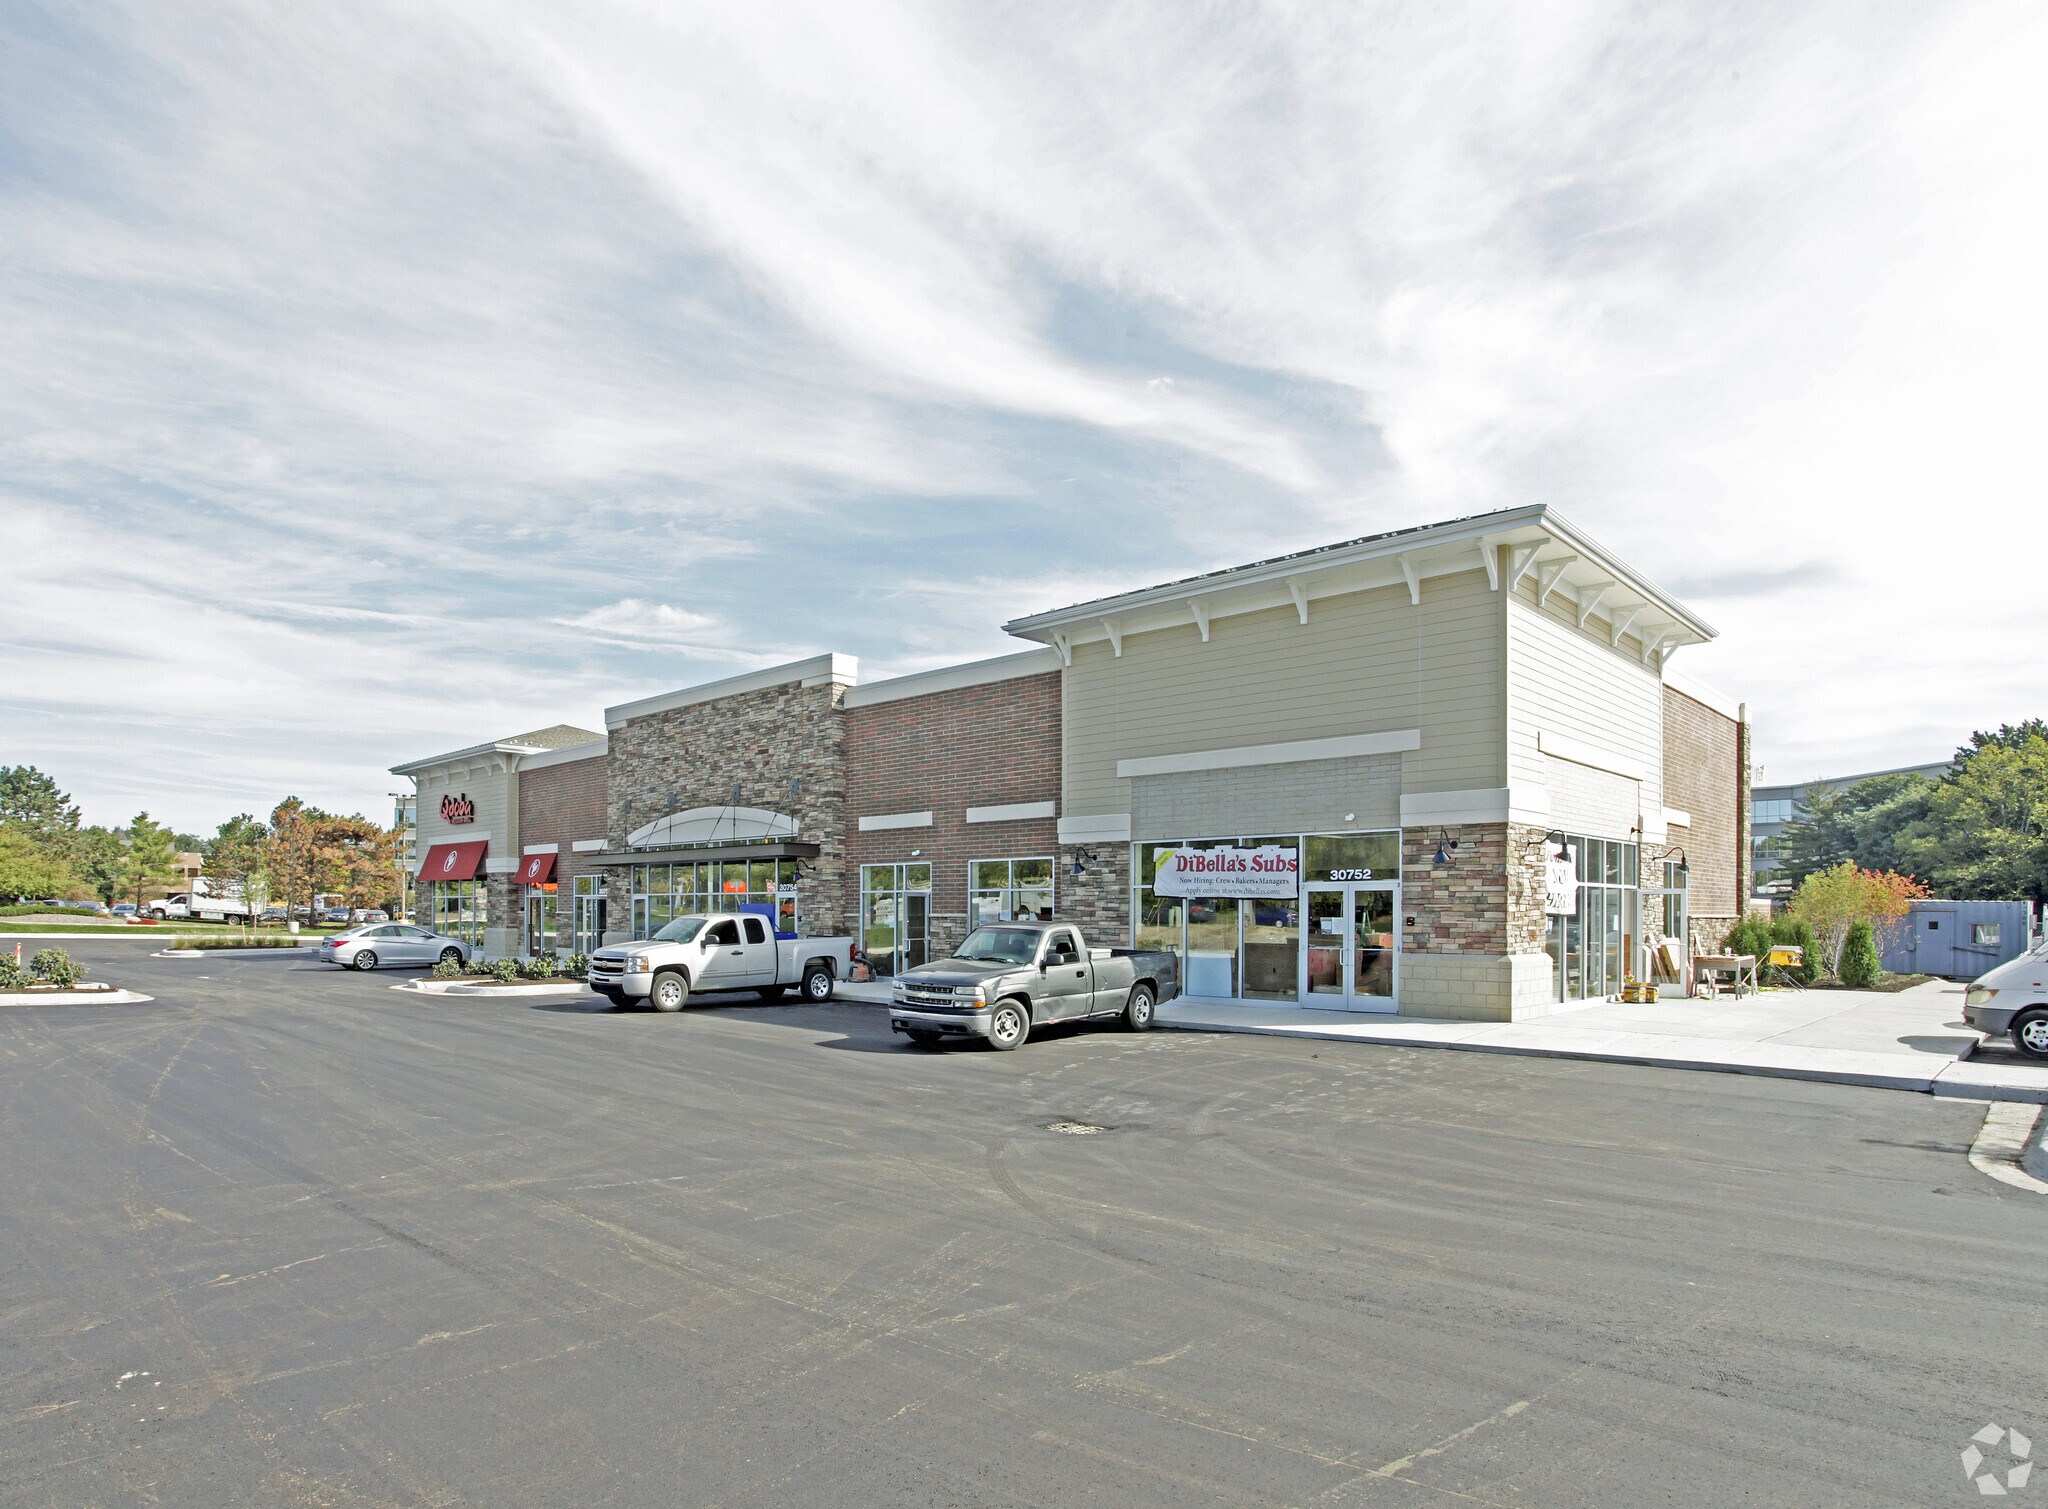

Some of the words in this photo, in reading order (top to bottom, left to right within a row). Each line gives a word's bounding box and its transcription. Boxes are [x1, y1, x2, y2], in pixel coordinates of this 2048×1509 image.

[1175, 854, 1247, 872] DiBella's
[1250, 853, 1297, 872] Subs
[1330, 868, 1372, 880] 30752
[1185, 887, 1200, 895] Apply
